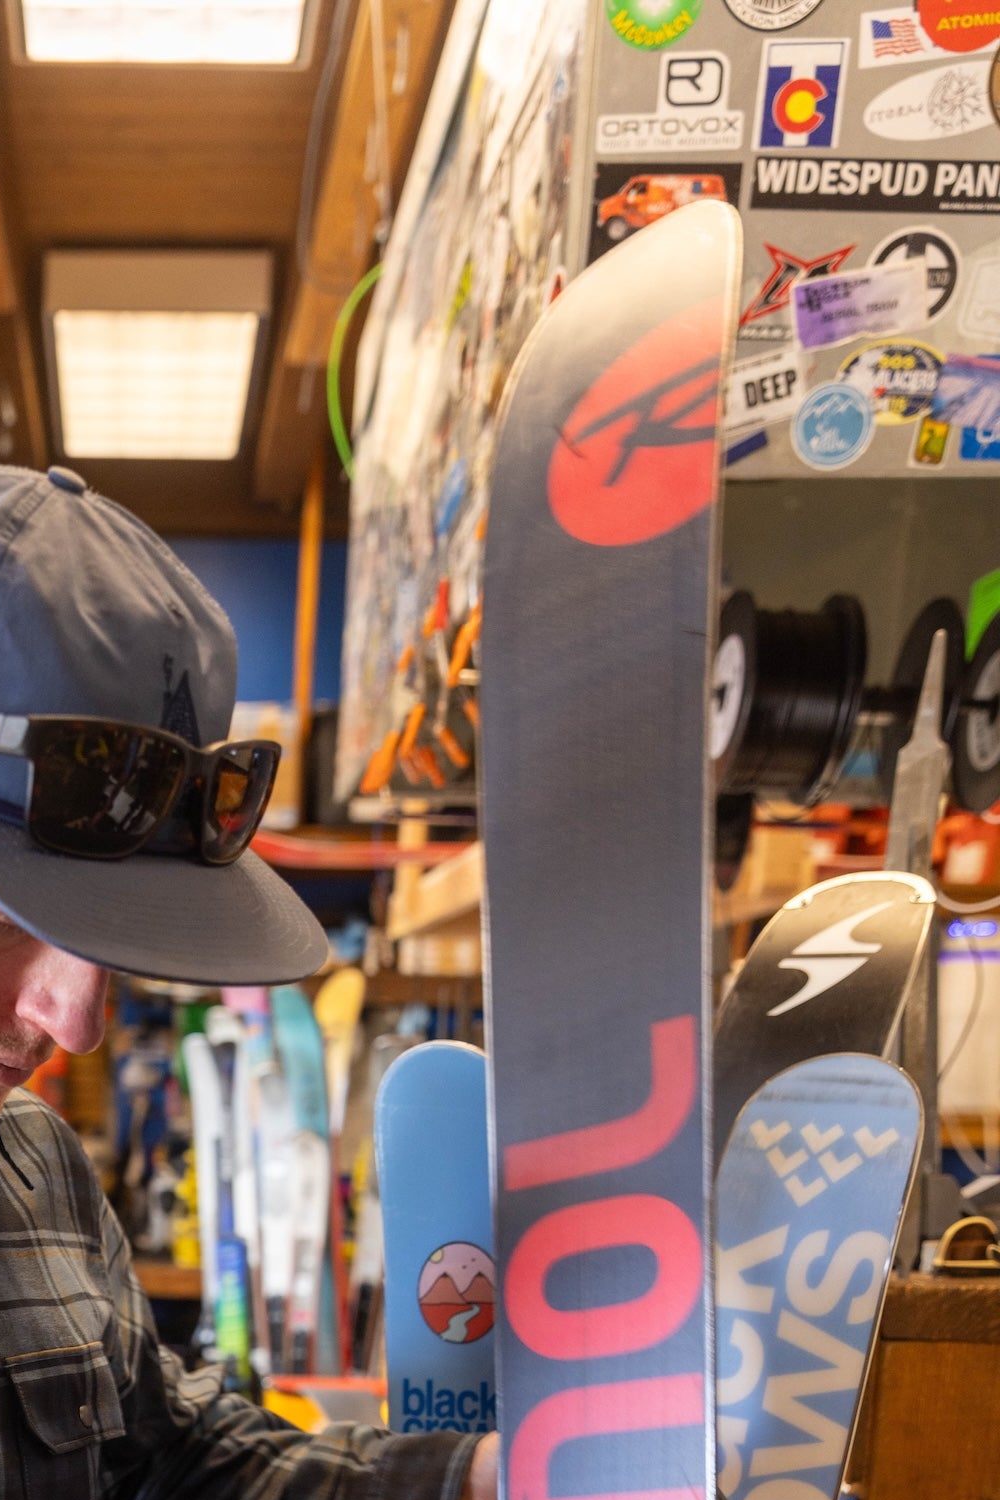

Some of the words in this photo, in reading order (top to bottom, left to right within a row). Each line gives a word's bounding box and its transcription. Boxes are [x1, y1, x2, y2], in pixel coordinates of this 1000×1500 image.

[602, 117, 739, 137] ORTOVOX
[757, 158, 929, 197] WIDESPUD
[933, 163, 1000, 198] PAN
[744, 369, 797, 408] DEEP
